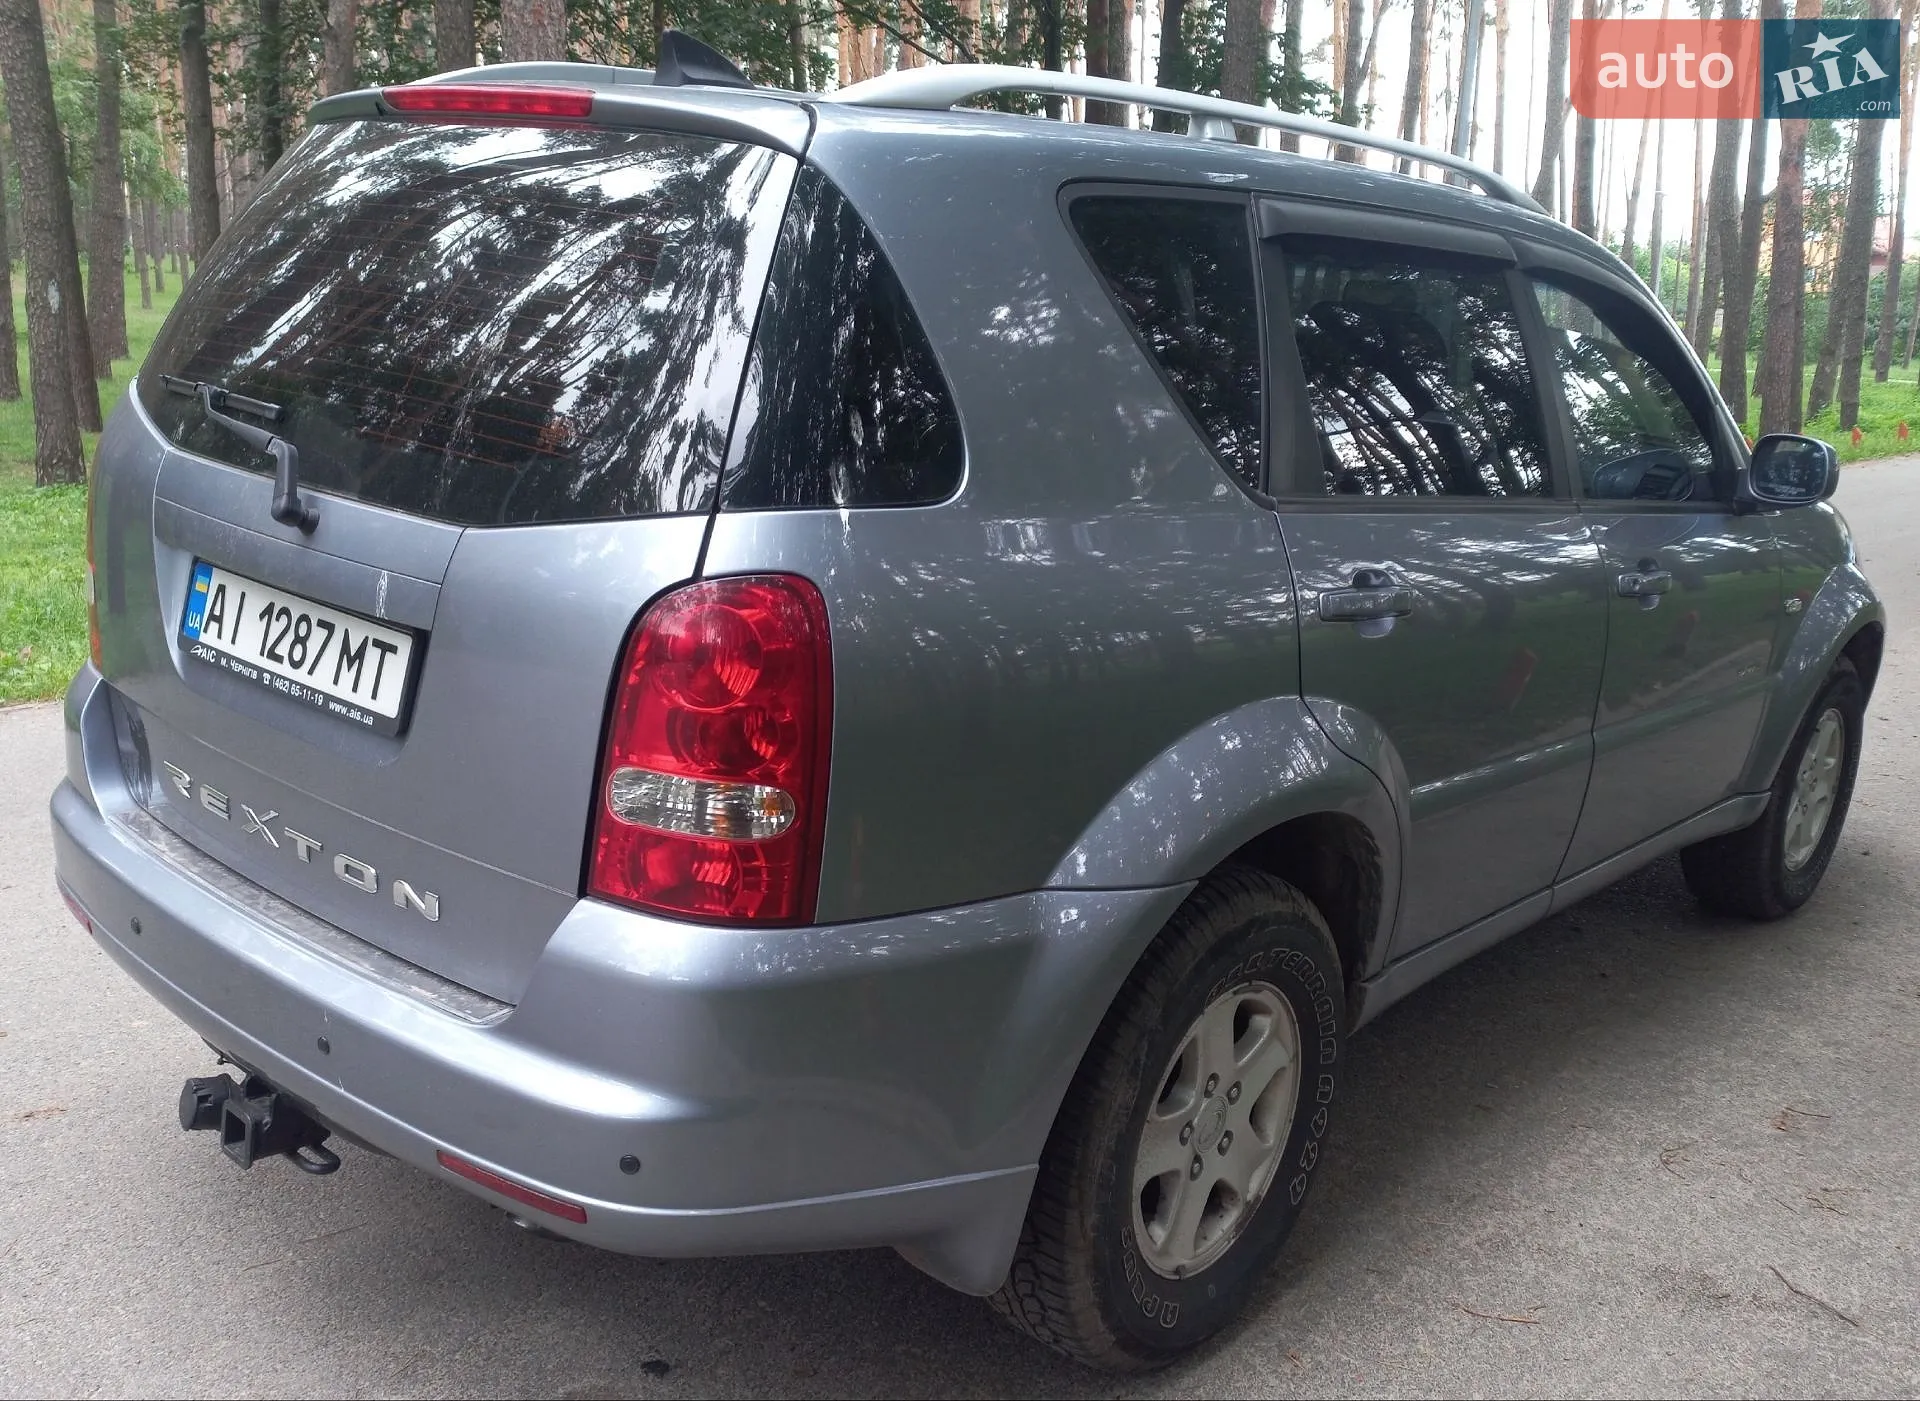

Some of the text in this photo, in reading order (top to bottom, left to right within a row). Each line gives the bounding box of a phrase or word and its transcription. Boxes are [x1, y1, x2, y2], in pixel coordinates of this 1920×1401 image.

[188, 614, 201, 631] UA
[203, 583, 398, 701] AI 1287 MT
[329, 700, 374, 725] www.ais.ua
[163, 760, 440, 922] REXTON
[1269, 946, 1338, 1066] TERRAIN
